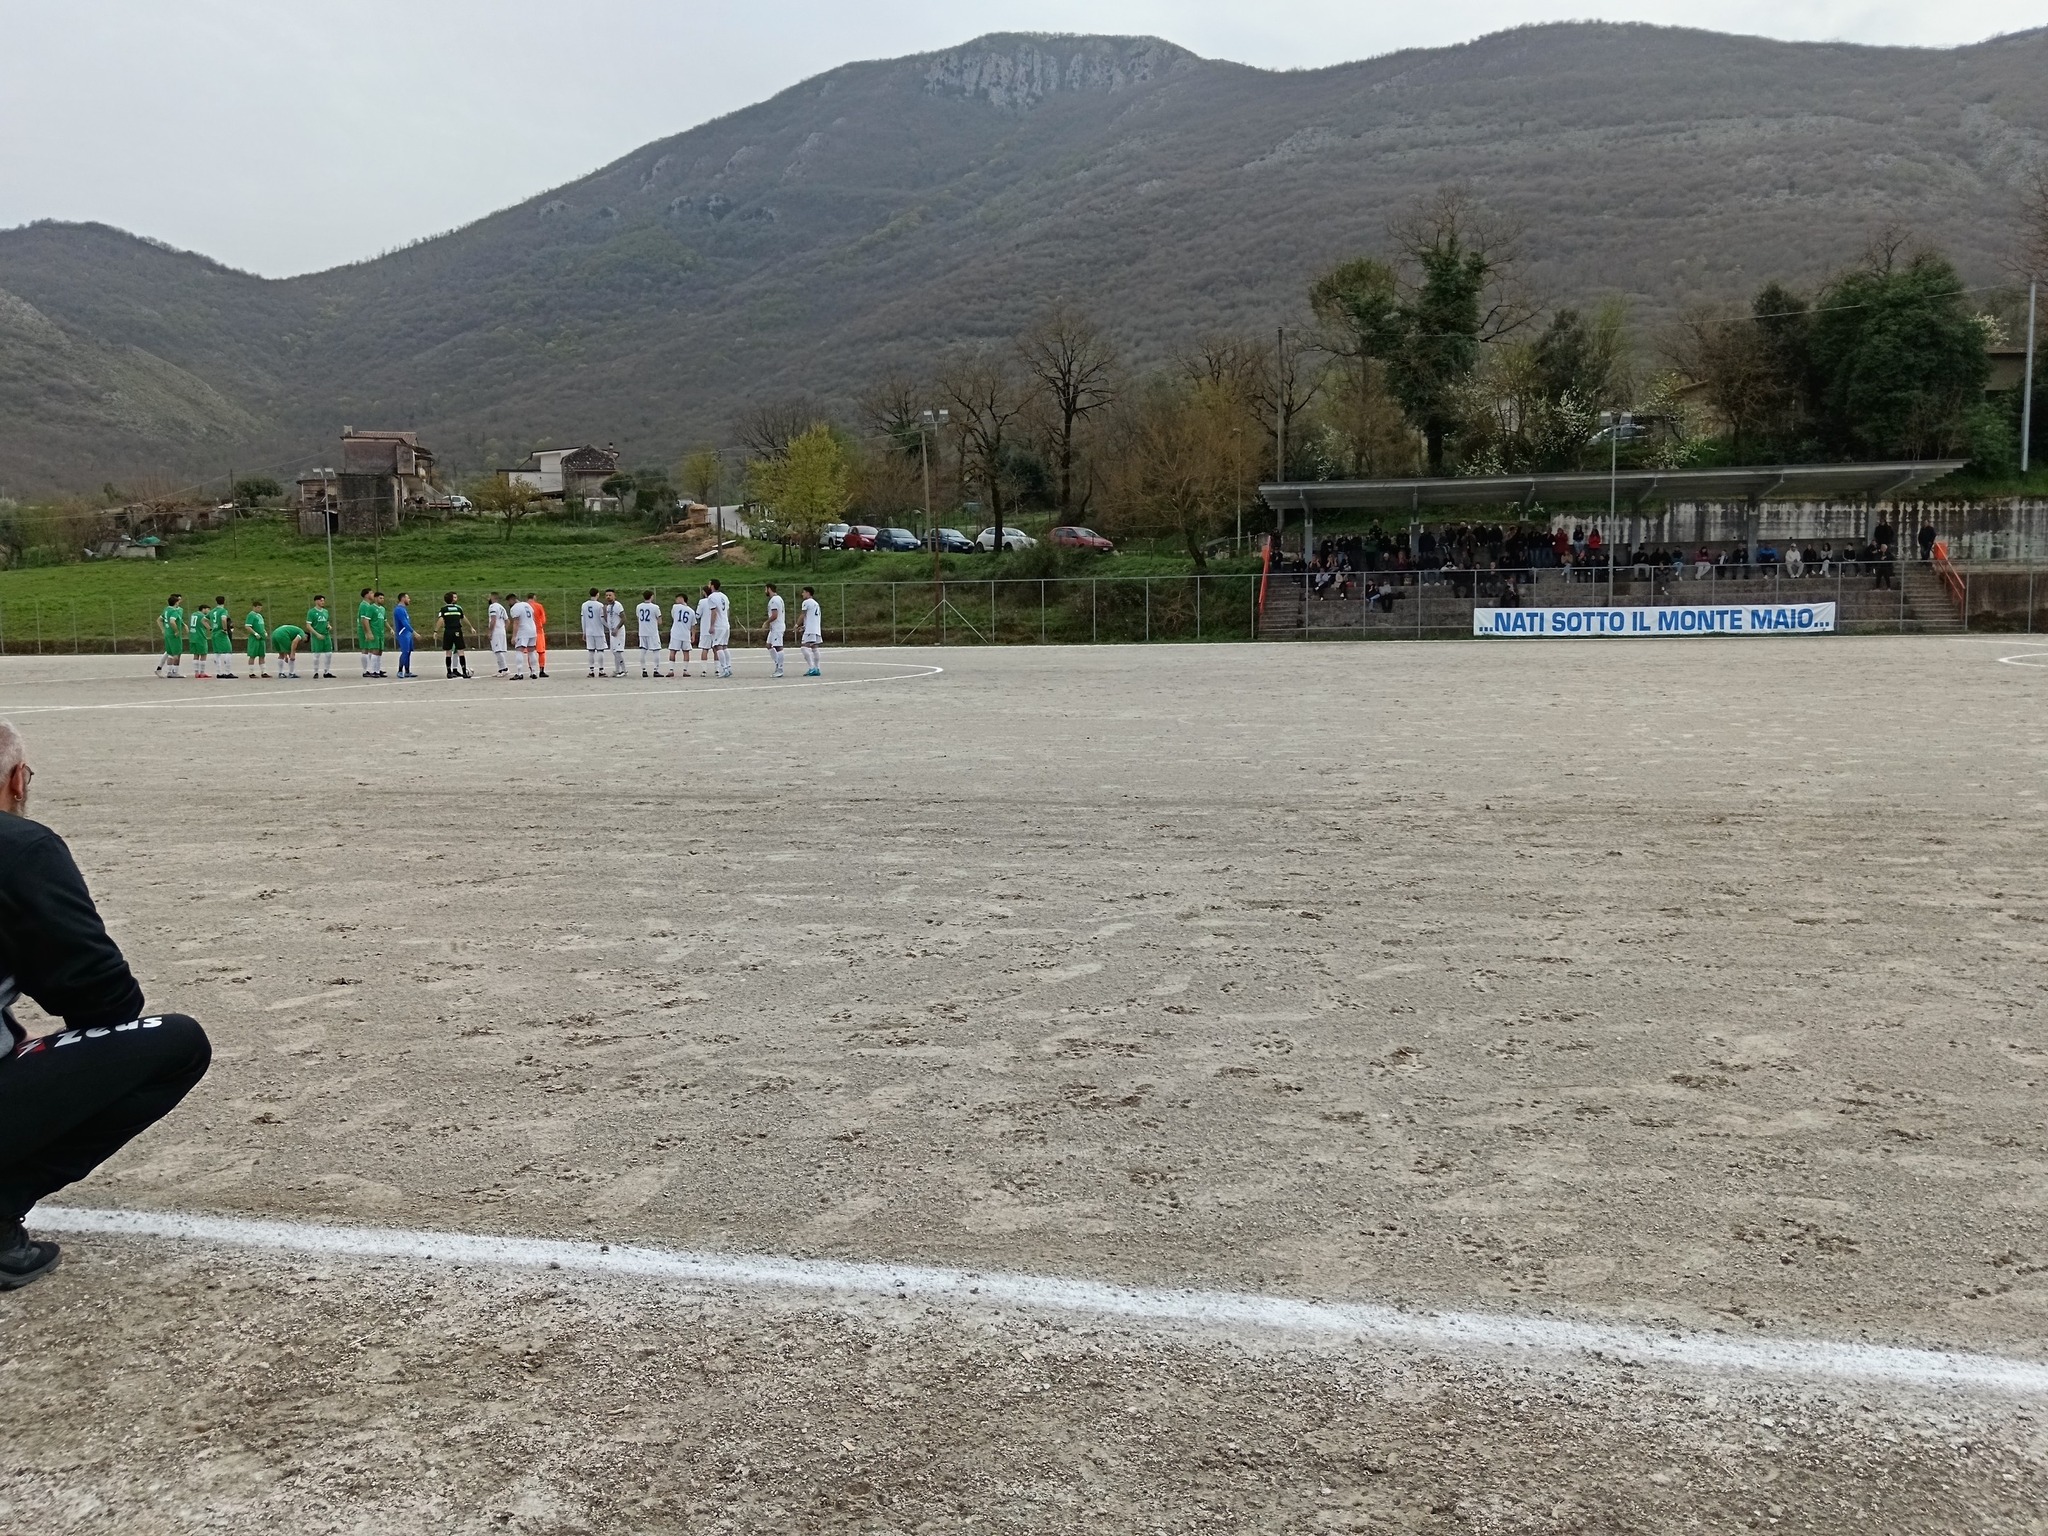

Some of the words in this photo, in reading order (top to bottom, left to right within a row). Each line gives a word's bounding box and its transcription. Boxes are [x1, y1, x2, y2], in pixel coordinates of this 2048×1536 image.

[587, 606, 594, 619] 5
[639, 609, 650, 622] 32
[678, 609, 689, 624] 16
[190, 615, 198, 627] 10
[1479, 612, 1545, 632] ...NATI
[1552, 611, 1625, 632] SOTTO
[1632, 611, 1651, 632] IL
[1658, 609, 1742, 631] MONTE
[1751, 607, 1830, 630] MAIO...
